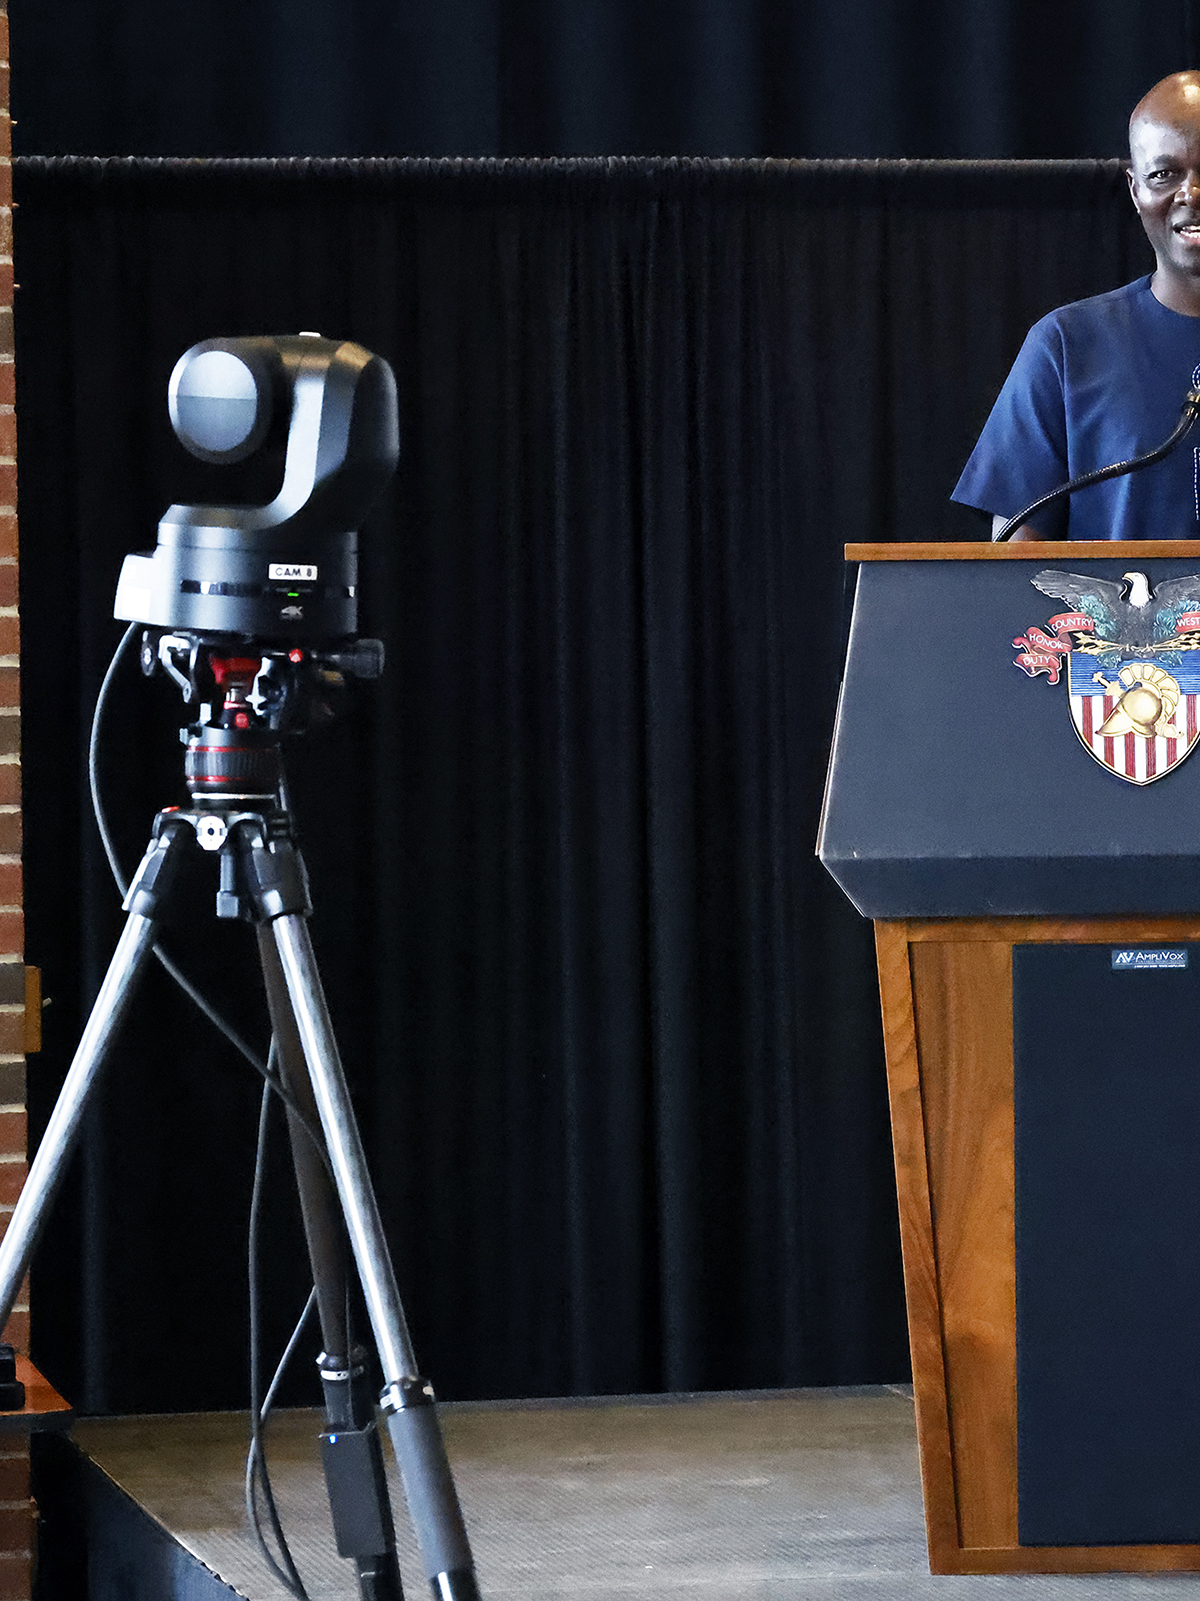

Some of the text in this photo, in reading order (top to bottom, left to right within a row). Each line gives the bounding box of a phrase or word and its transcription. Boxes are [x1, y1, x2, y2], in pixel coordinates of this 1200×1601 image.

[275, 567, 301, 577] CAM
[1051, 617, 1093, 632] COUNTRY
[1176, 616, 1200, 627] WEST
[1029, 633, 1064, 650] HONOR
[1022, 655, 1051, 666] DUTY
[1135, 951, 1184, 962] AMPLIVOX
